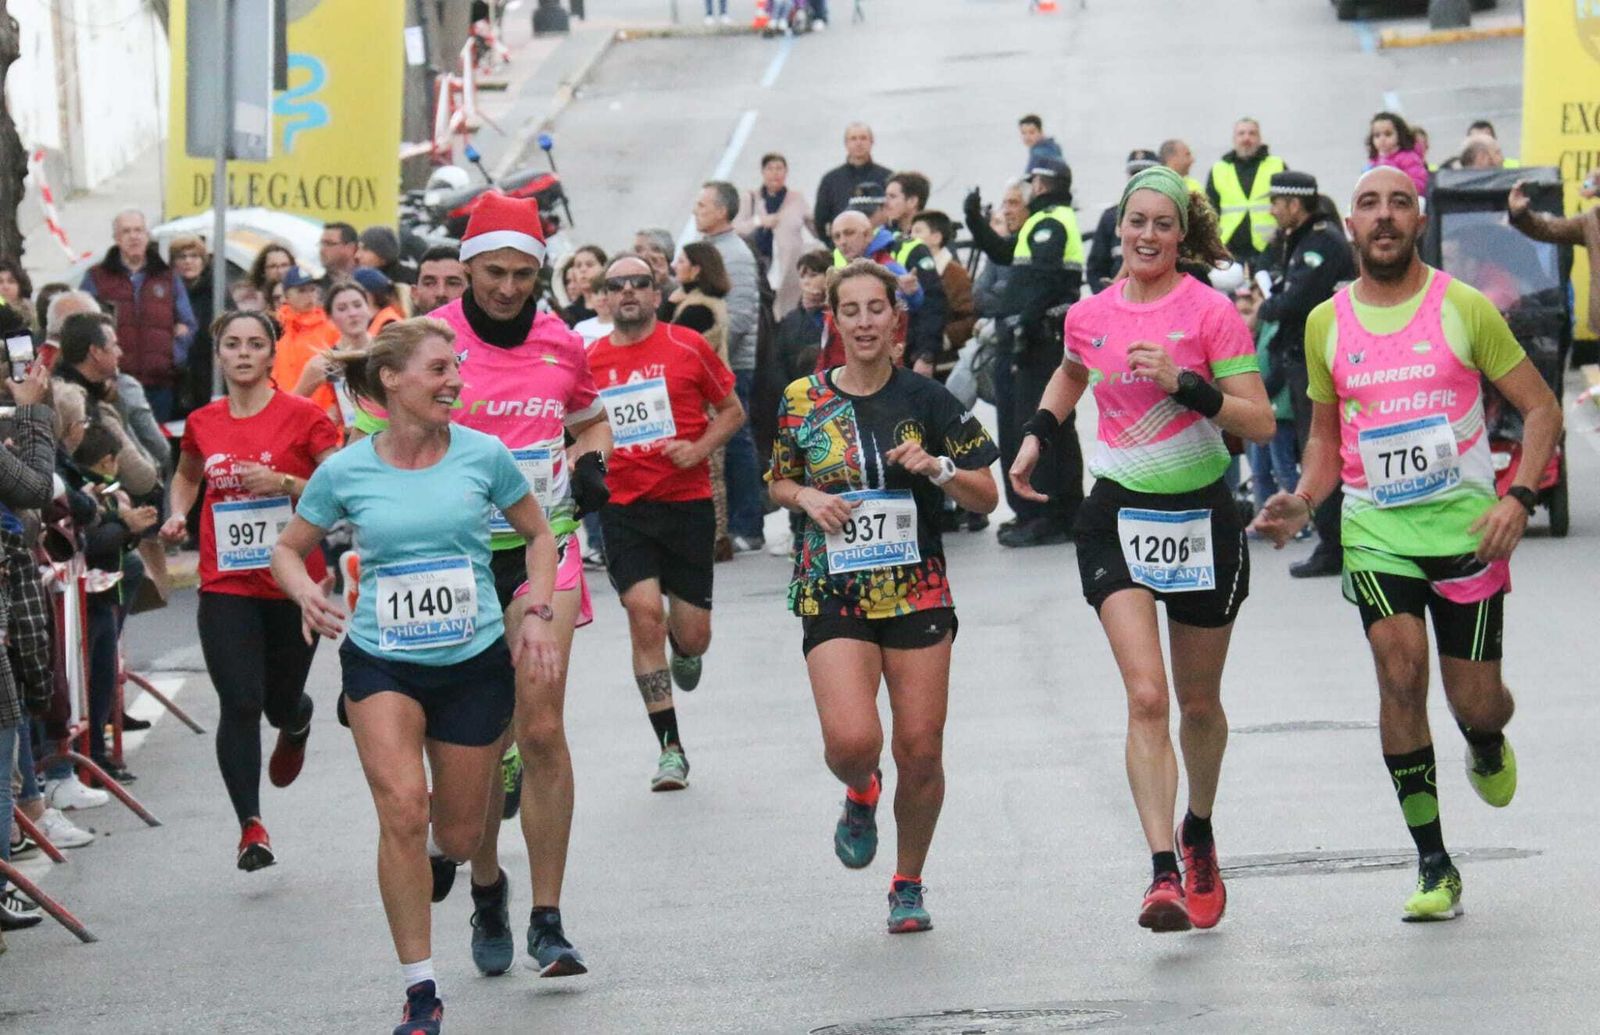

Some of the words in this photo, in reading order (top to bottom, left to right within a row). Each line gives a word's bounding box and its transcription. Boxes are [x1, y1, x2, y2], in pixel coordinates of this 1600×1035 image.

[1346, 363, 1436, 389] MARRERO
[614, 401, 648, 426] 526
[613, 419, 675, 440] HICLANA
[1378, 445, 1428, 478] 776
[1373, 466, 1460, 505] CHICLANA
[228, 521, 267, 547] 997
[843, 513, 887, 544] 937
[220, 548, 272, 568] CHICLA
[831, 541, 918, 570] CHICLANA
[1129, 534, 1190, 564] 1206
[1130, 564, 1211, 587] CHICLANA
[388, 586, 453, 620] 1140
[382, 618, 475, 648] CHICLANA
